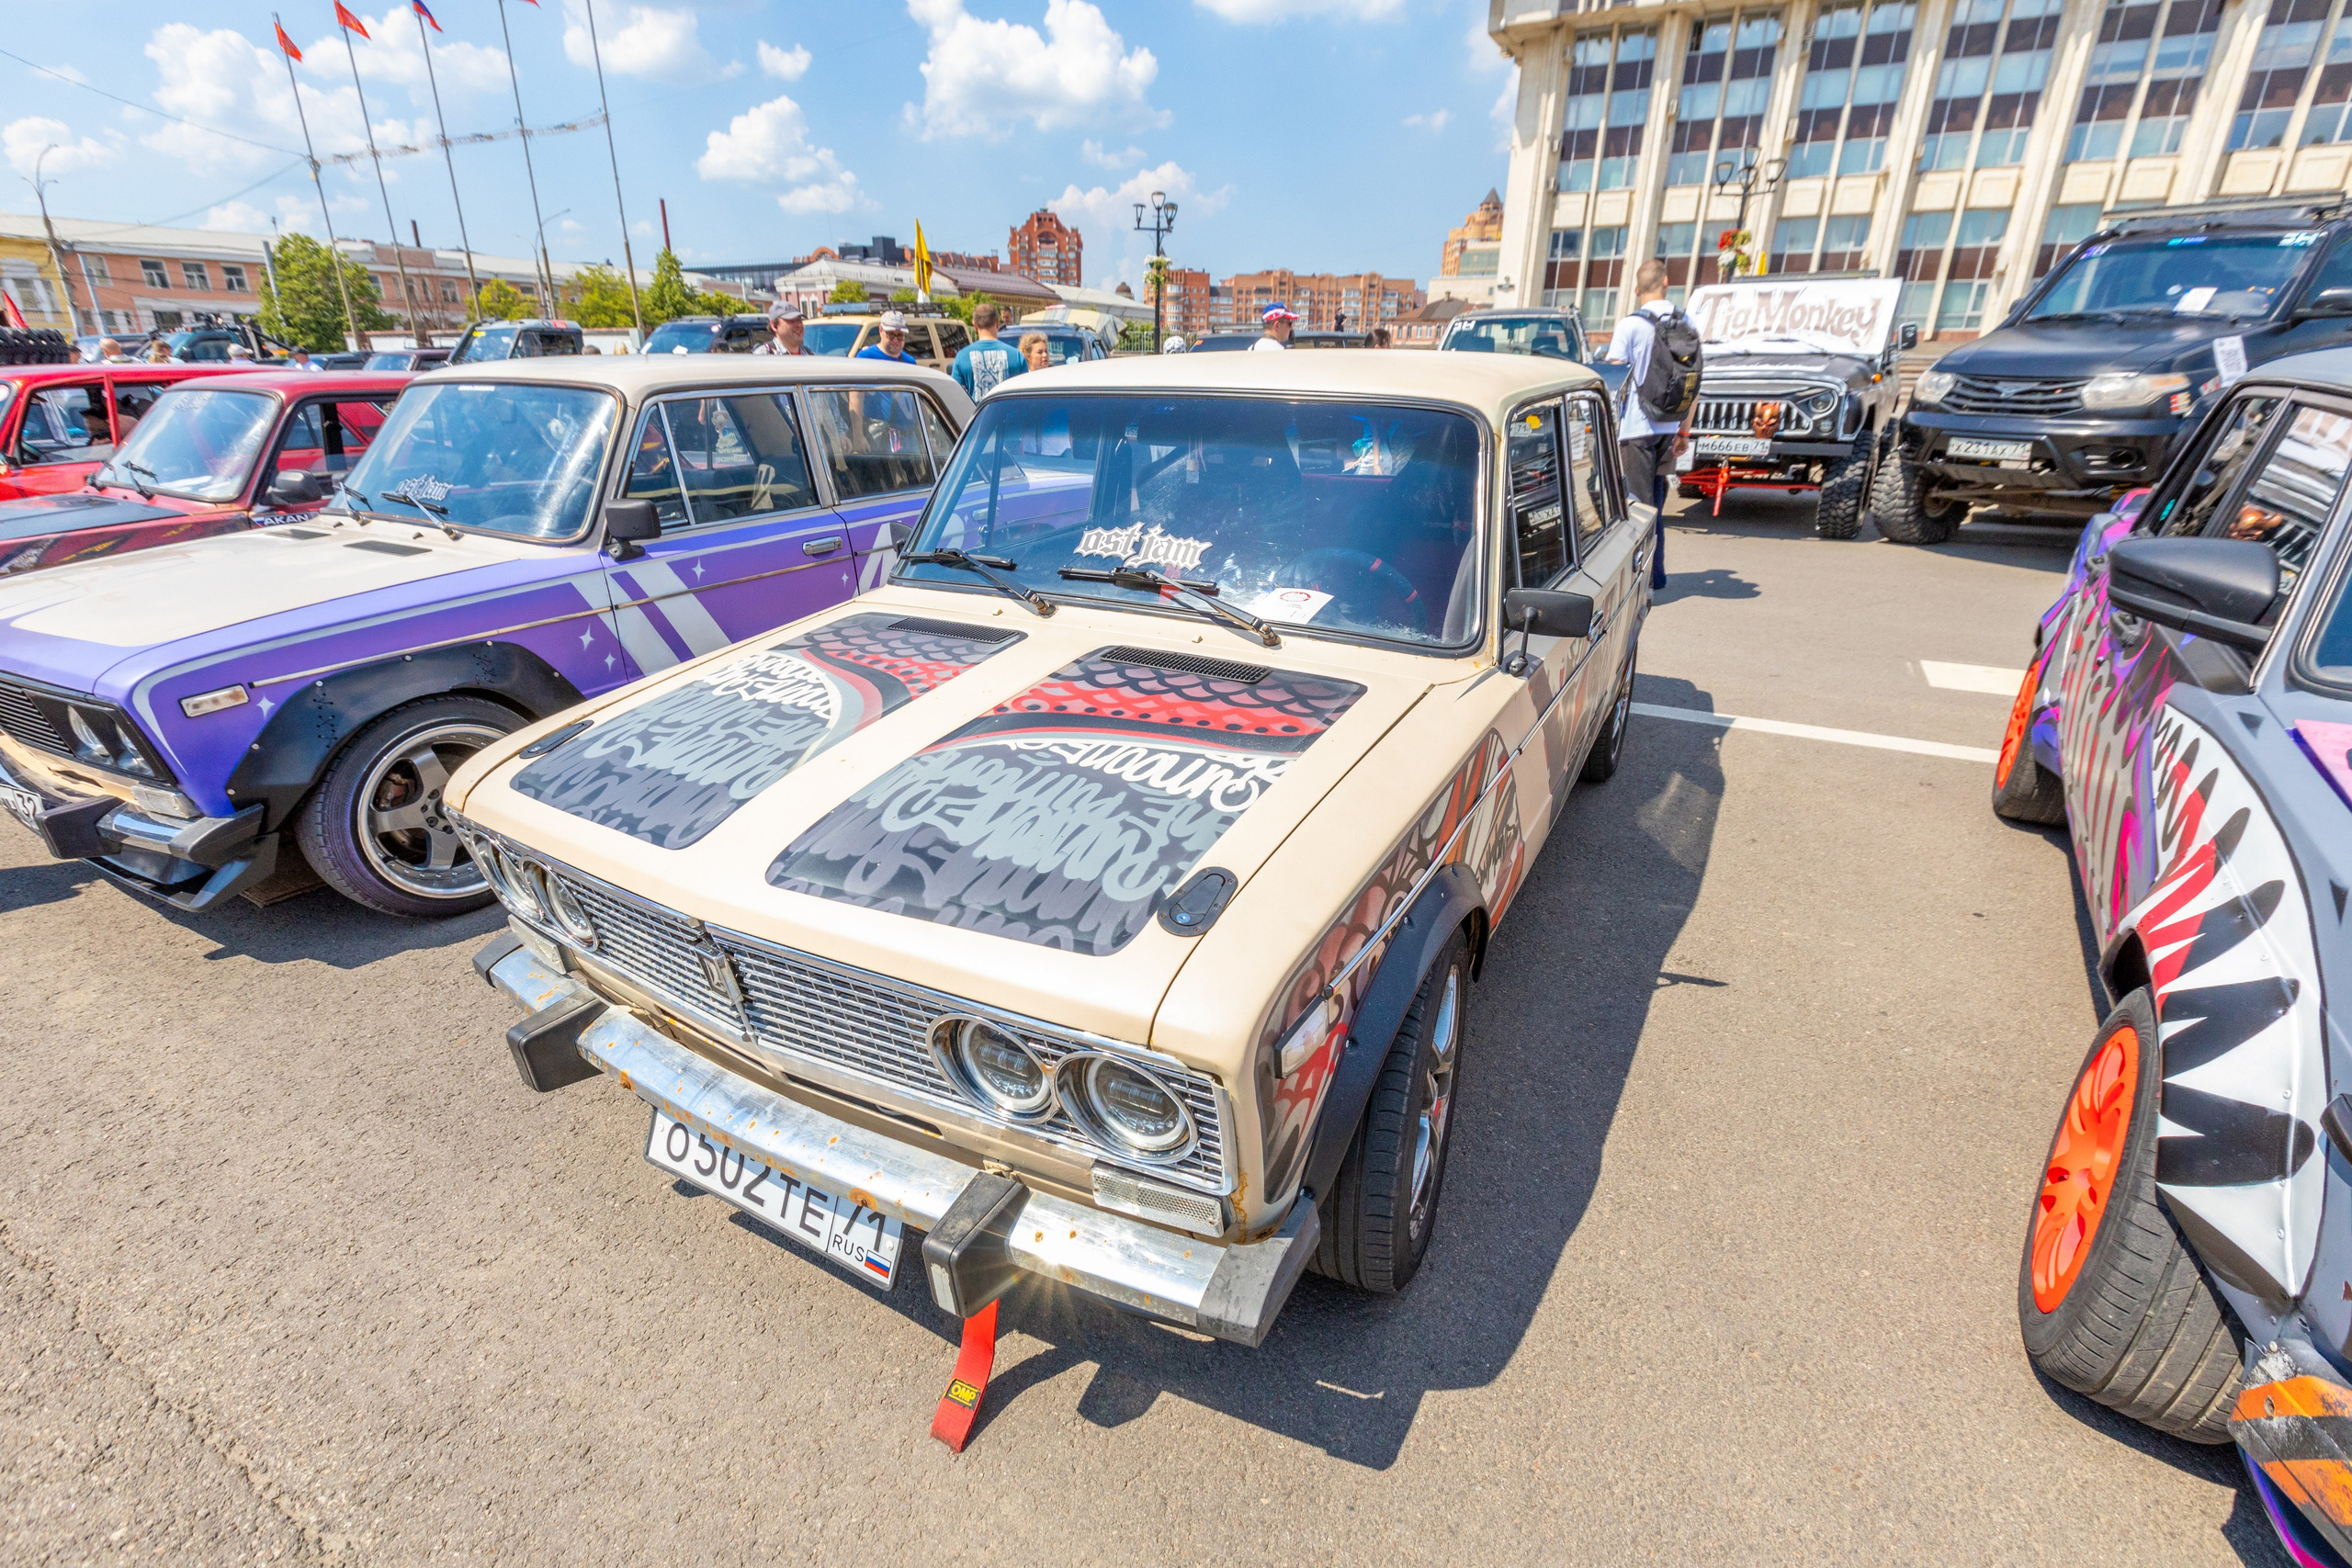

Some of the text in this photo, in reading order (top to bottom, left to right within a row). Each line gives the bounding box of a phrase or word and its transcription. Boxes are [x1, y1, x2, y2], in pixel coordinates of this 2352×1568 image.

[1073, 521, 1214, 571] ost jam
[831, 1234, 865, 1262] RUS
[951, 1383, 977, 1403] OMP
